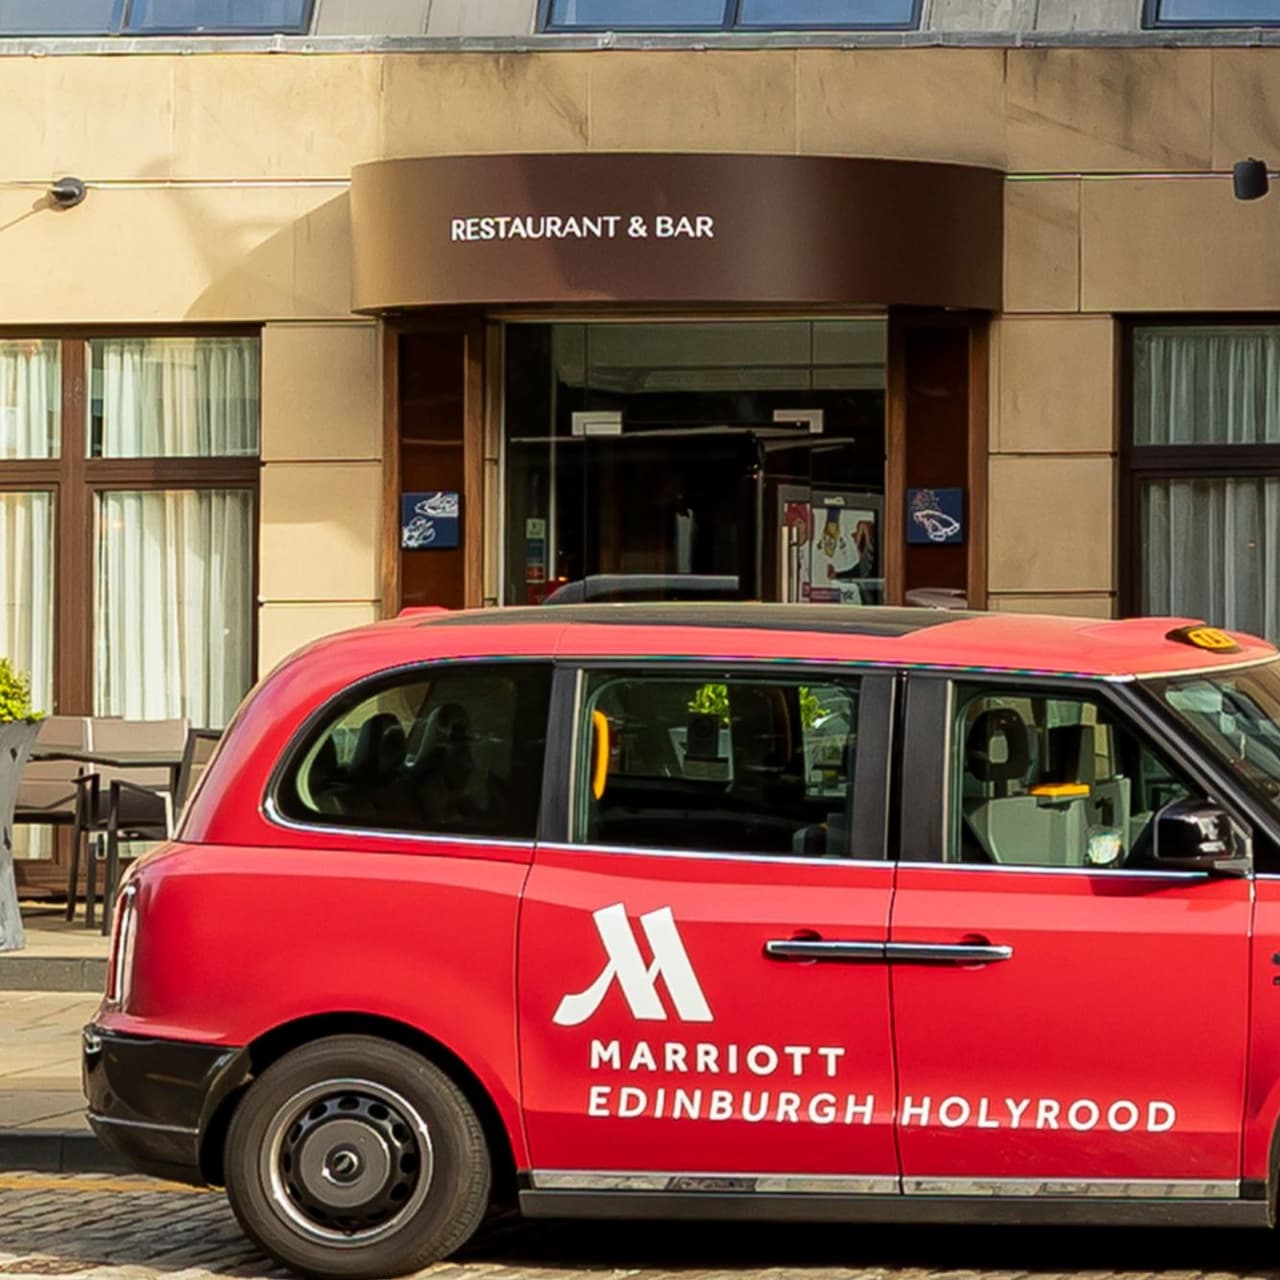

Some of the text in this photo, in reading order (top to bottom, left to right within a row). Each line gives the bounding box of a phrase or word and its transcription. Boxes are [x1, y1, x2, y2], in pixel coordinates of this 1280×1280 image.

[451, 215, 714, 241] RESTAURANT & BAR
[589, 1039, 845, 1077] MARRIOTT
[587, 1086, 1177, 1132] EDINBURGH HOLYROOD
